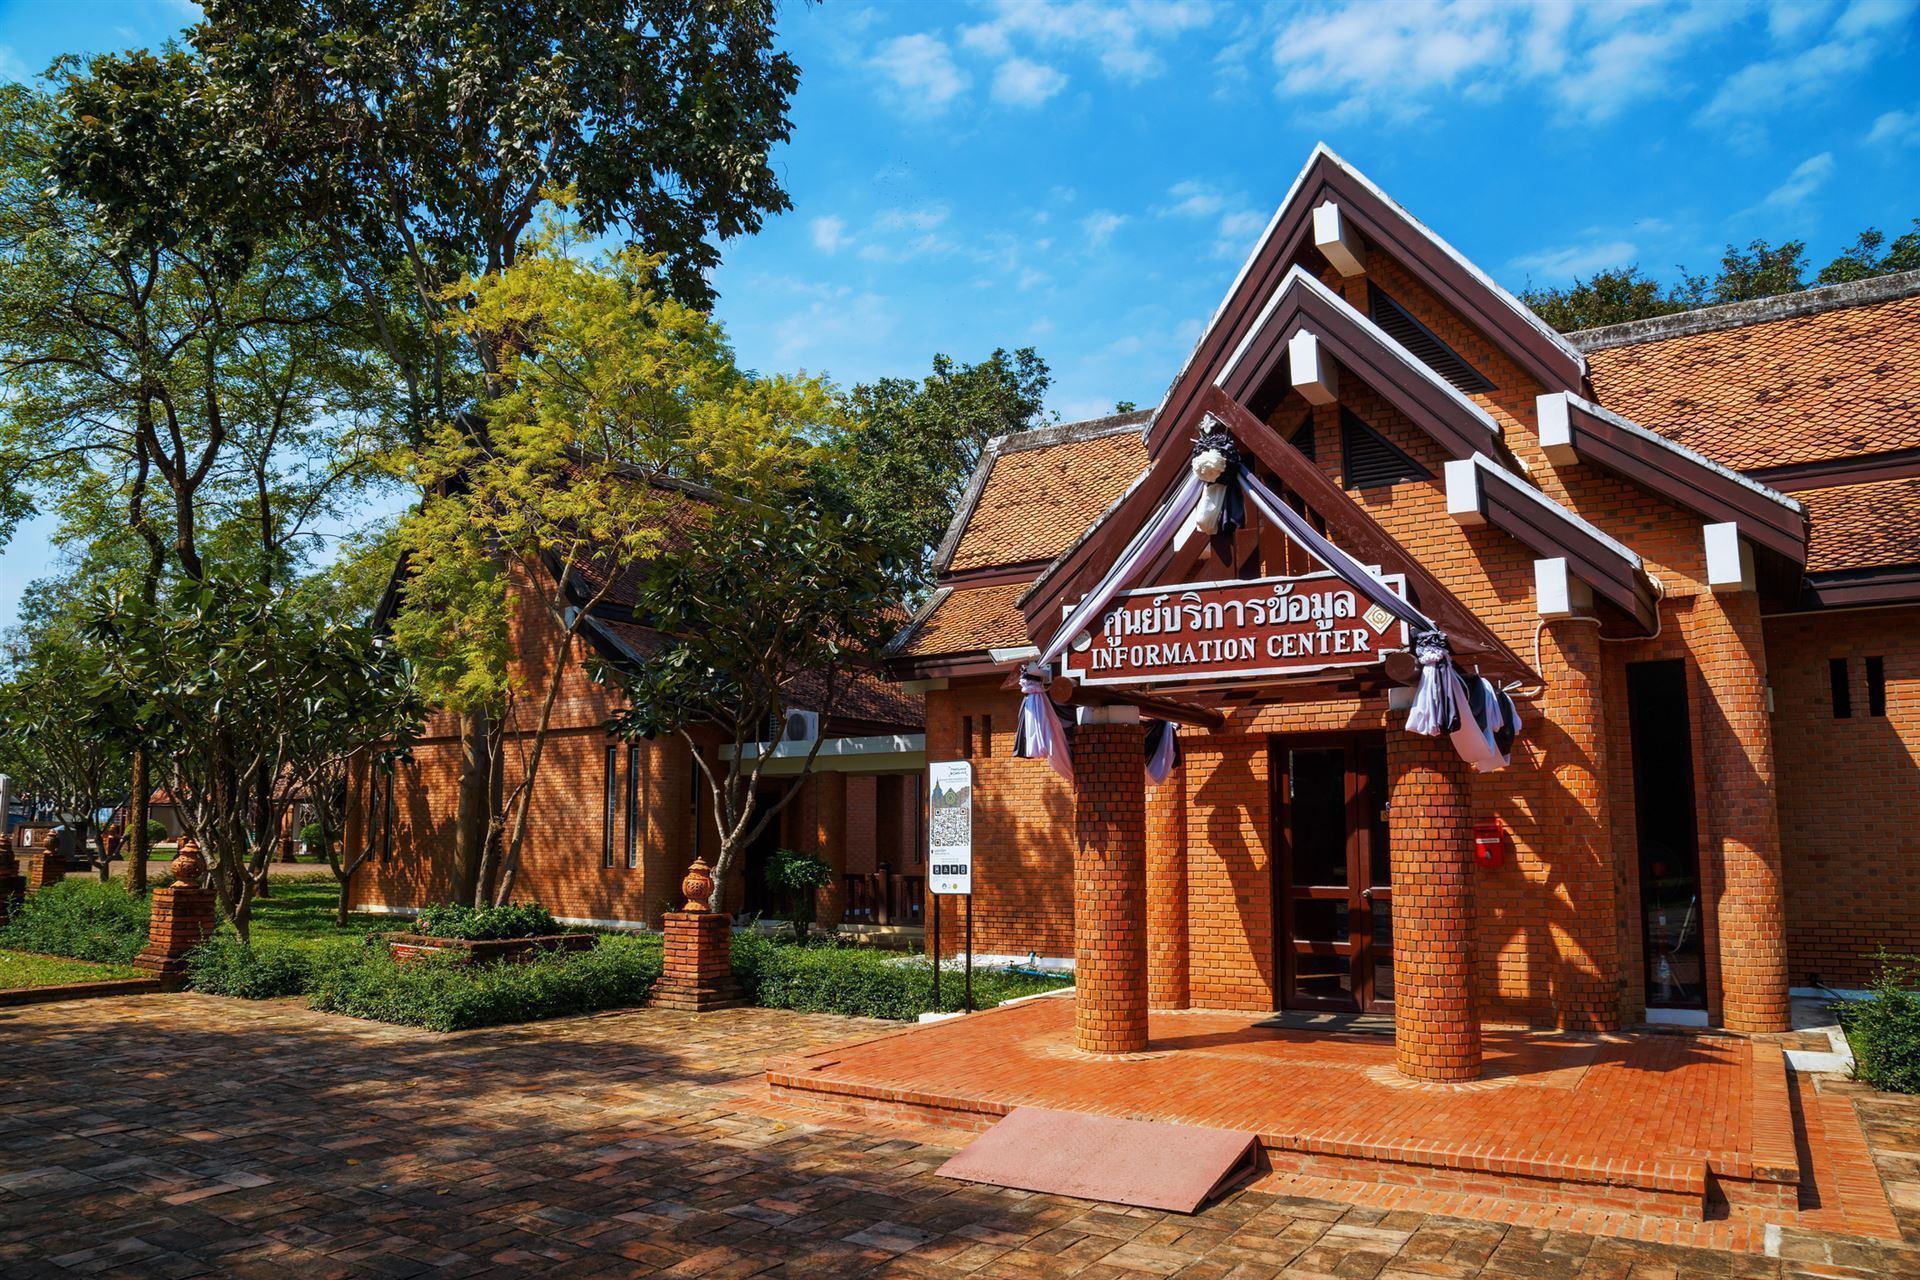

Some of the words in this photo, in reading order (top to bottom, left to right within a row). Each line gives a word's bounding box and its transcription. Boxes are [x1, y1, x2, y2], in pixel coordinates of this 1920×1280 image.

[1103, 583, 1356, 647] ศูนย์บริการข้อมูล
[1091, 637, 1256, 670] INFORMATION
[1267, 629, 1370, 657] CENTER
